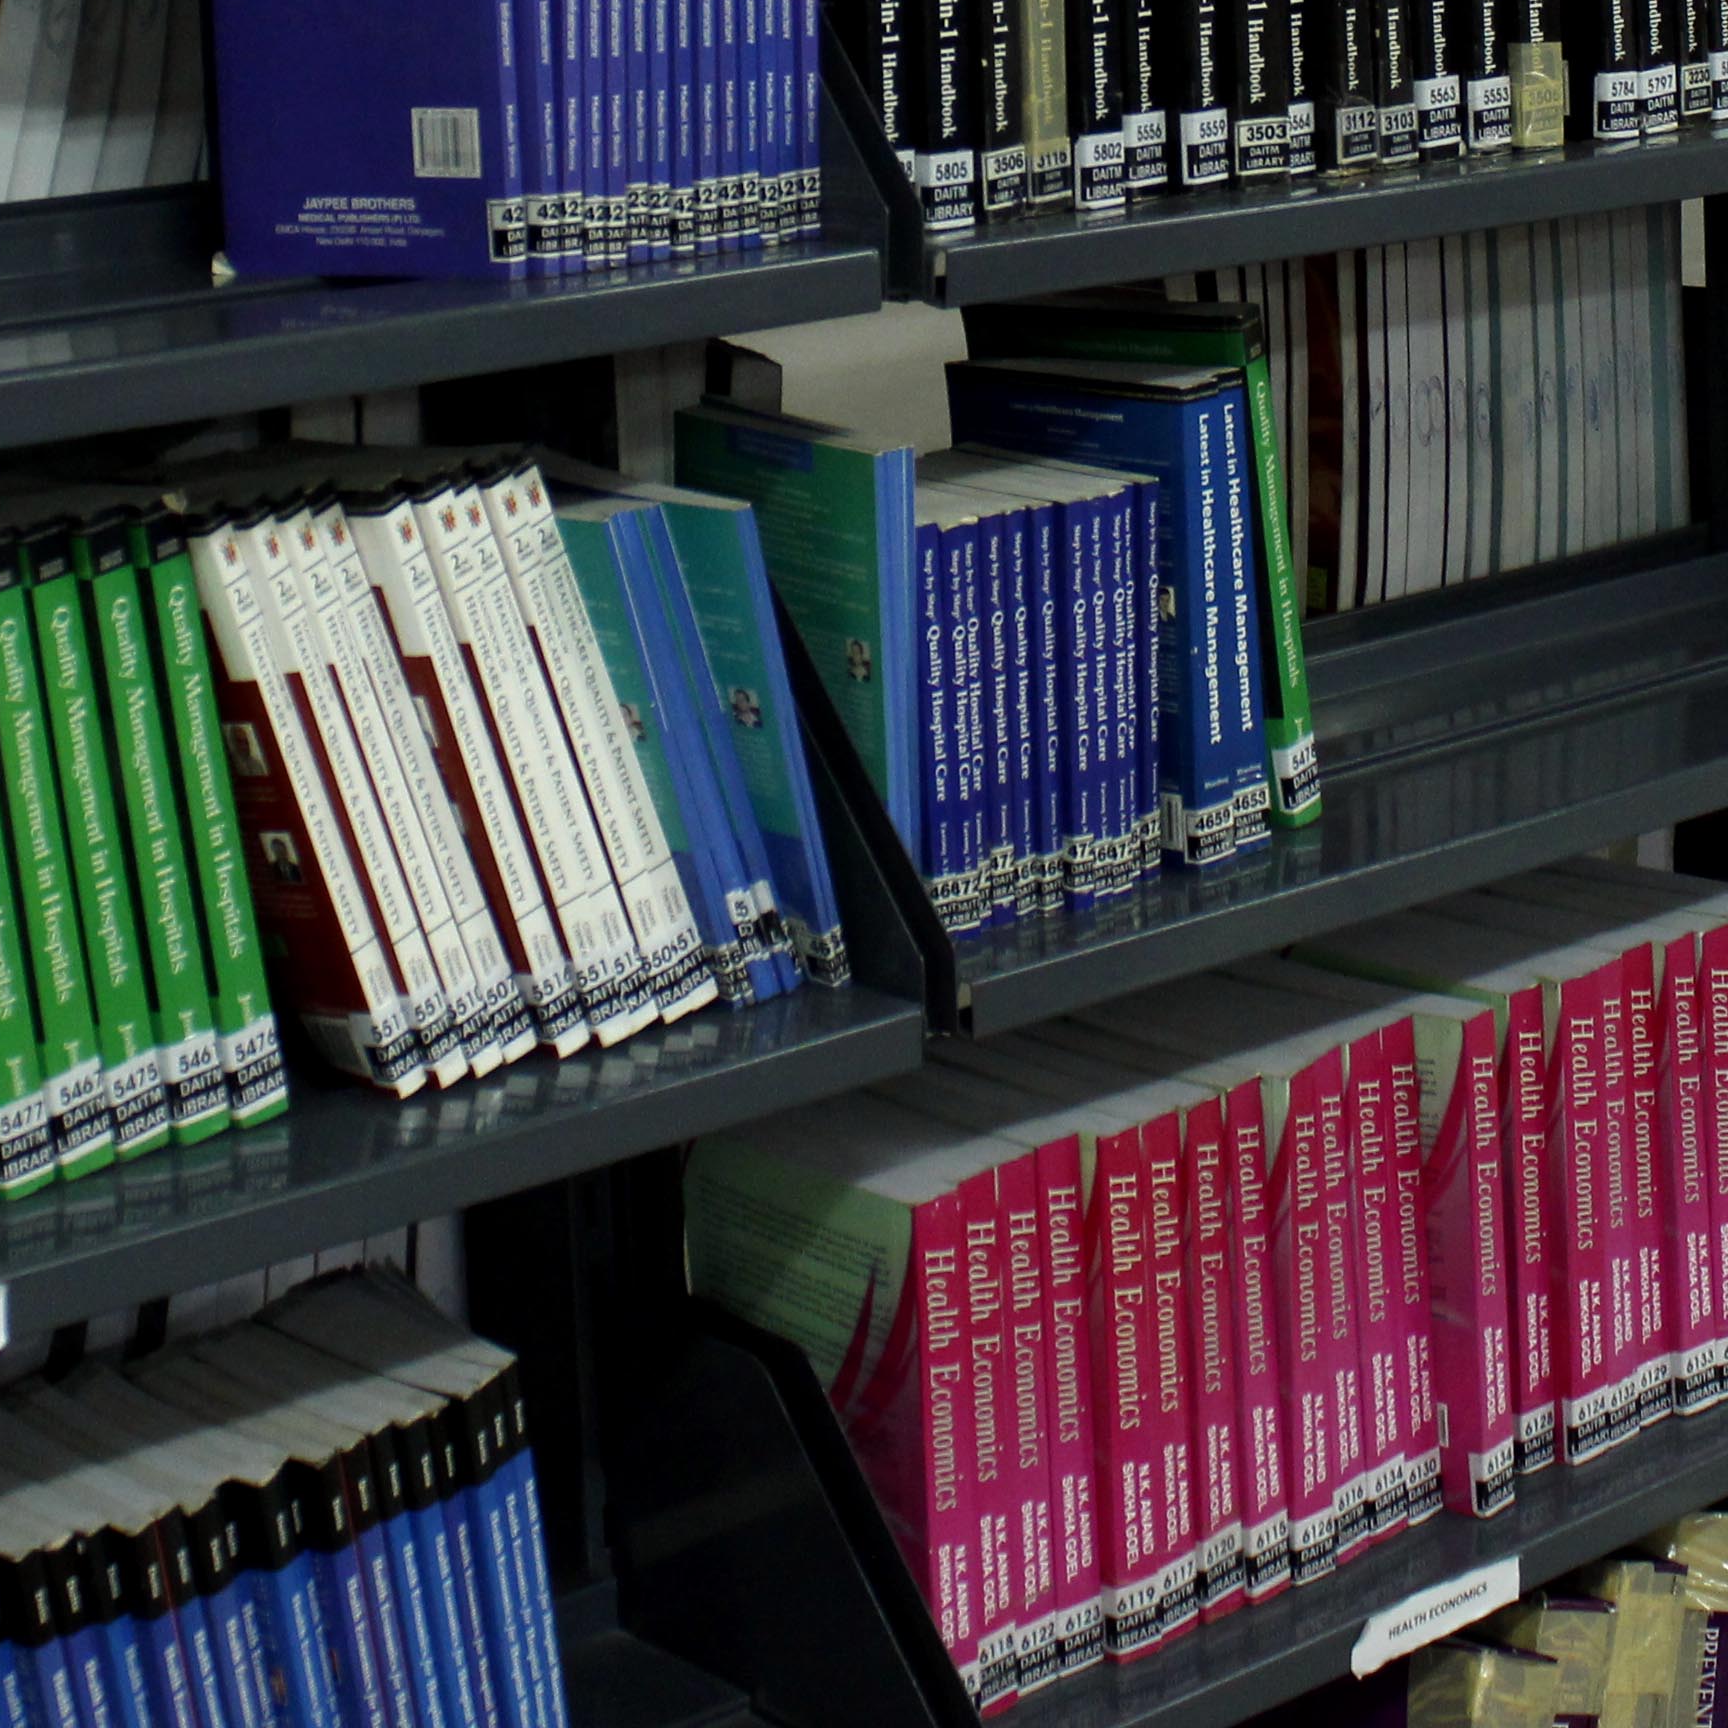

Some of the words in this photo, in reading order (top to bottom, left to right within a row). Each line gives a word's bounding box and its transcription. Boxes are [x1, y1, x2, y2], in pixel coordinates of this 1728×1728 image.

[940, 46, 957, 141] Handbook
[1429, 87, 1456, 104] 5563
[1246, 125, 1287, 141] 3503
[1384, 113, 1414, 129] 3103
[1133, 144, 1162, 161] DAITM
[936, 162, 968, 181] 5805
[303, 197, 347, 210] JAYPEE
[351, 198, 415, 210] BROTHERS
[934, 185, 968, 202] DAITM
[1198, 414, 1209, 467] Latest
[1200, 472, 1209, 487] in
[1201, 492, 1216, 604] Healthcare
[992, 612, 1005, 671] Quality
[1206, 607, 1220, 744] Management
[993, 675, 1008, 744] Hospital
[998, 748, 1008, 784] Care
[497, 698, 523, 762] QUALITY
[524, 779, 550, 839] PATIENT
[544, 841, 566, 891] SAFETY
[1197, 811, 1231, 829] 4659
[0, 1101, 43, 1133] 5477
[0, 1127, 47, 1158] DAITM
[1049, 1186, 1081, 1286] Health
[1054, 1298, 1082, 1444] Economics
[1686, 1351, 1715, 1374] 6133
[1062, 1476, 1075, 1533] SHIKHA
[1079, 1506, 1092, 1567] ANAND
[1066, 1537, 1077, 1583] GOEL
[1117, 1587, 1155, 1613] 6119
[1388, 1610, 1426, 1641] HEALTH
[1427, 1581, 1487, 1624] ECONOMICS
[1065, 1606, 1100, 1632] 6123
[1116, 1608, 1156, 1632] DAITM
